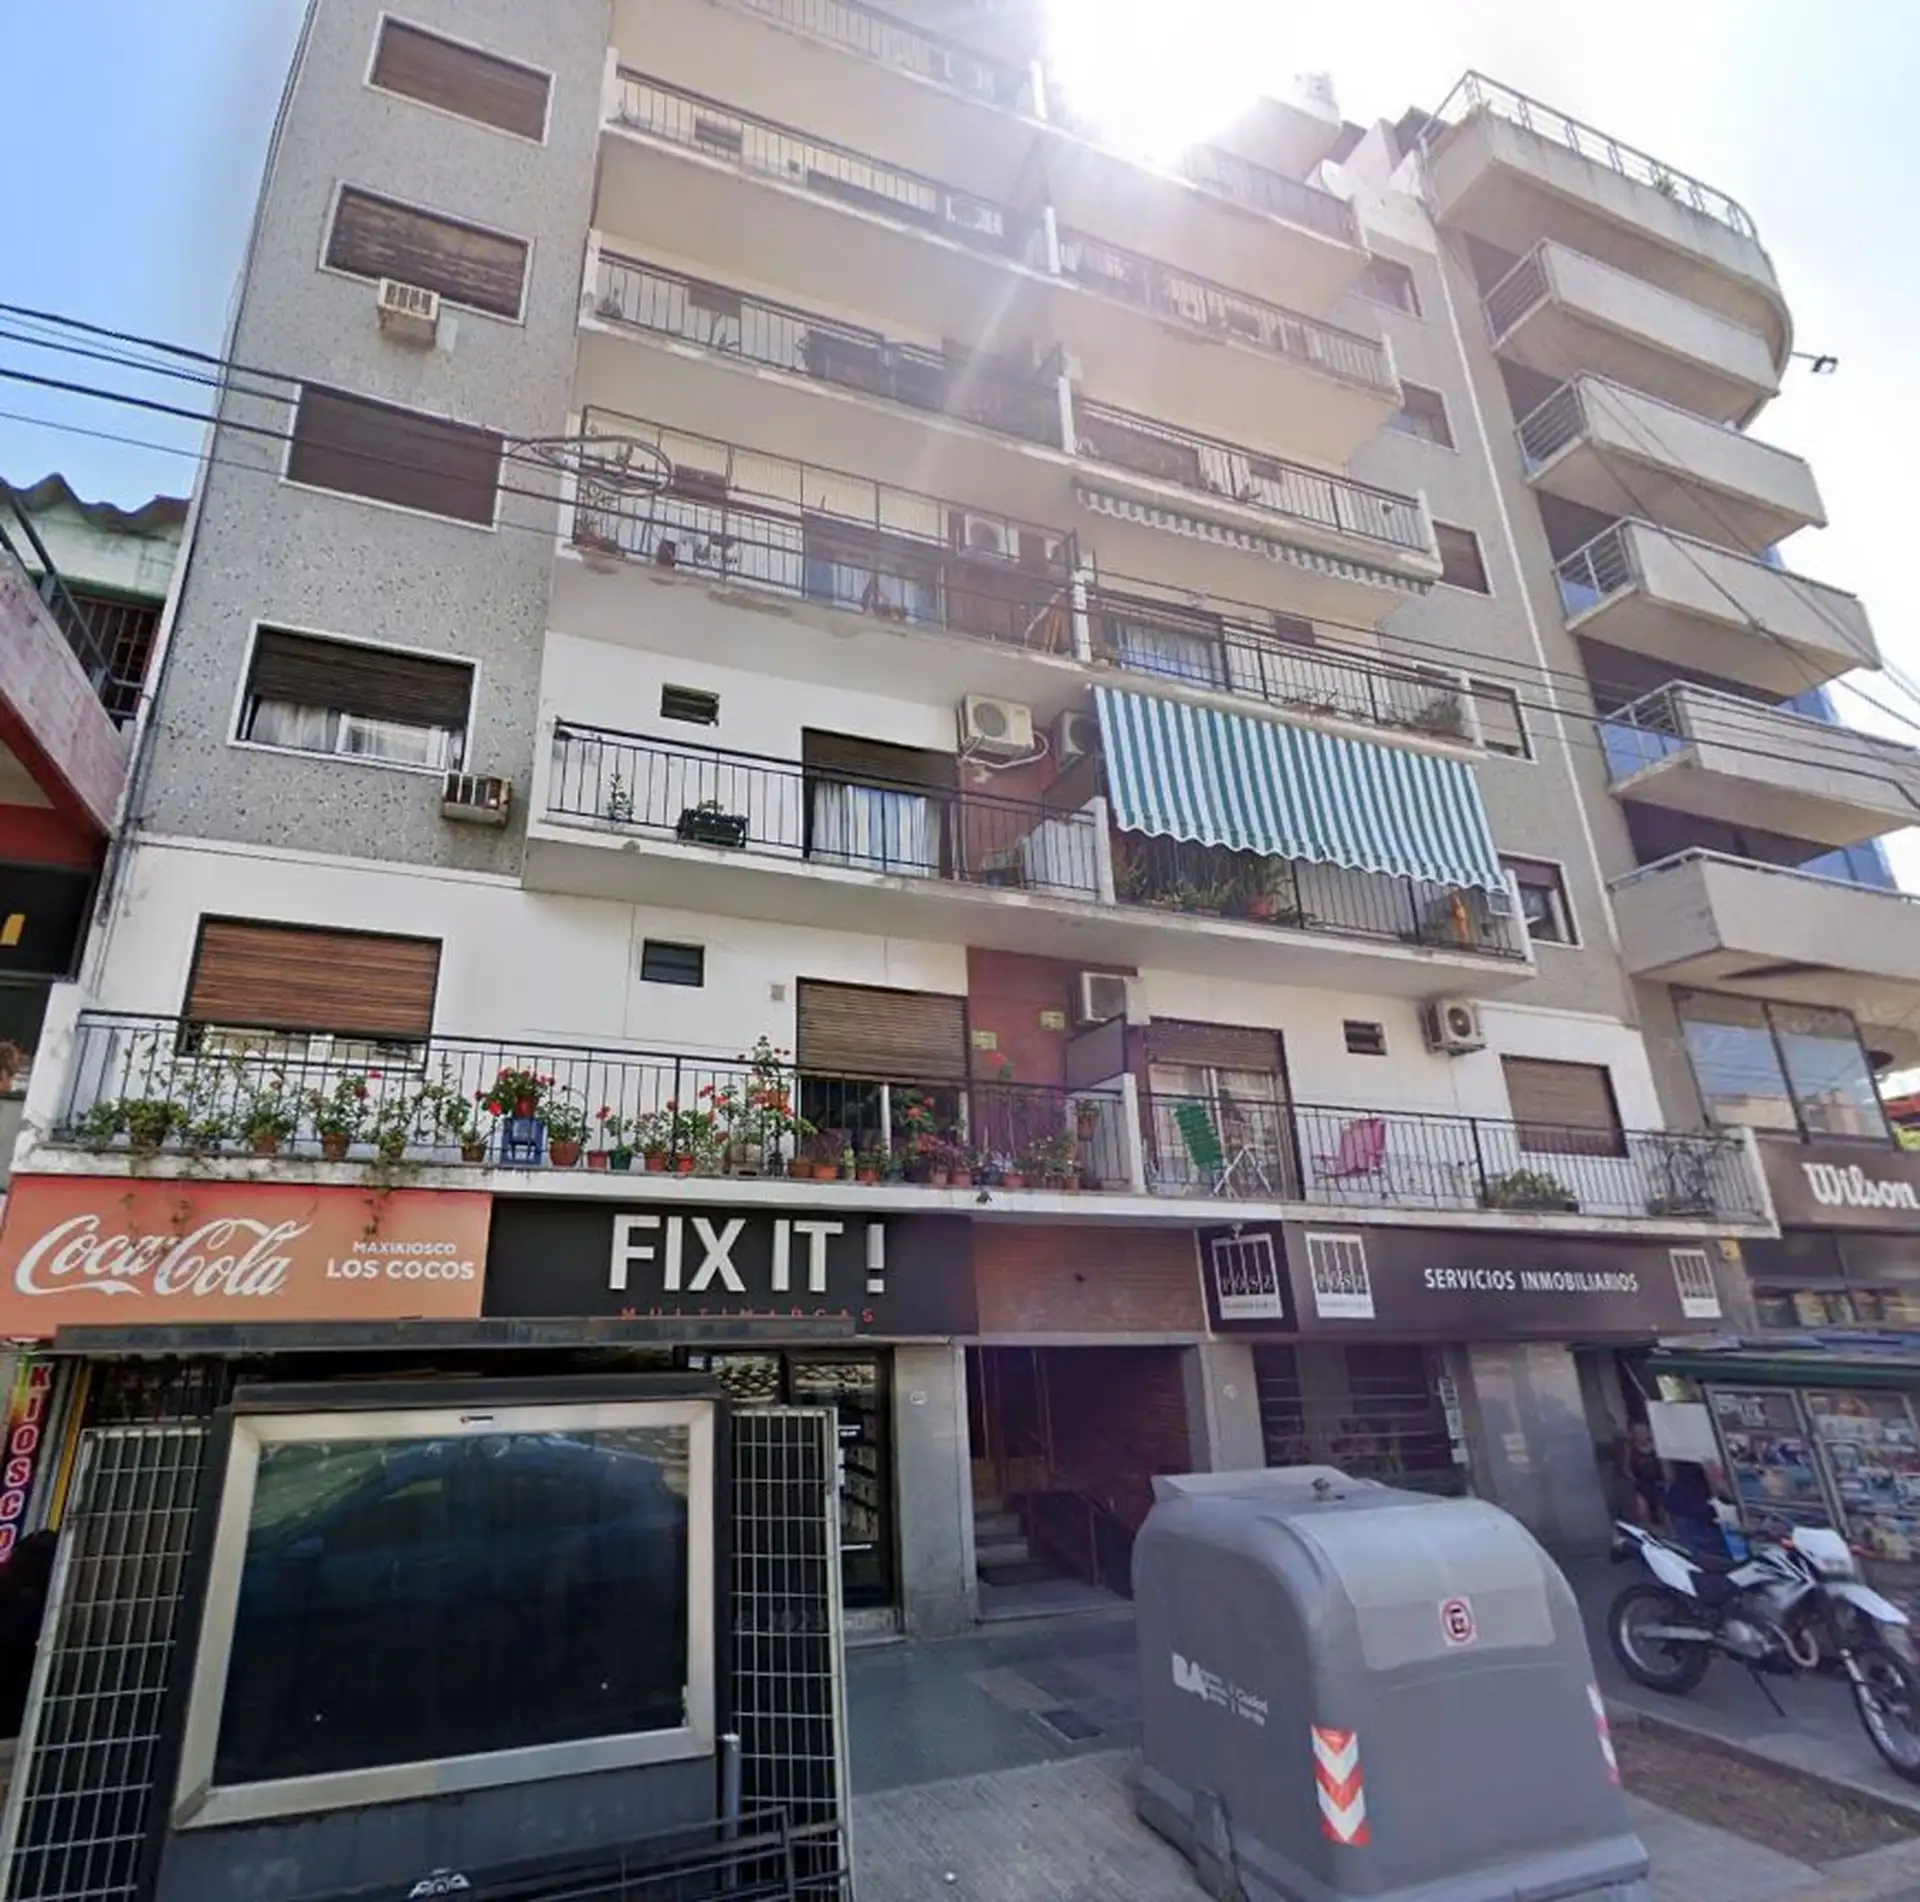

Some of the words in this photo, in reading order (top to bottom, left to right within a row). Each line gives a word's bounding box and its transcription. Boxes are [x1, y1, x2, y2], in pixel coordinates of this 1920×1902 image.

[1802, 1162, 1920, 1210] Wilson
[326, 1257, 379, 1279] LOS
[386, 1259, 476, 1281] COCOS
[608, 1213, 747, 1292] FIX
[772, 1218, 844, 1294] IT
[1424, 1267, 1516, 1291] SERVICIOS
[1519, 1270, 1640, 1293] INMOBILIARIOS
